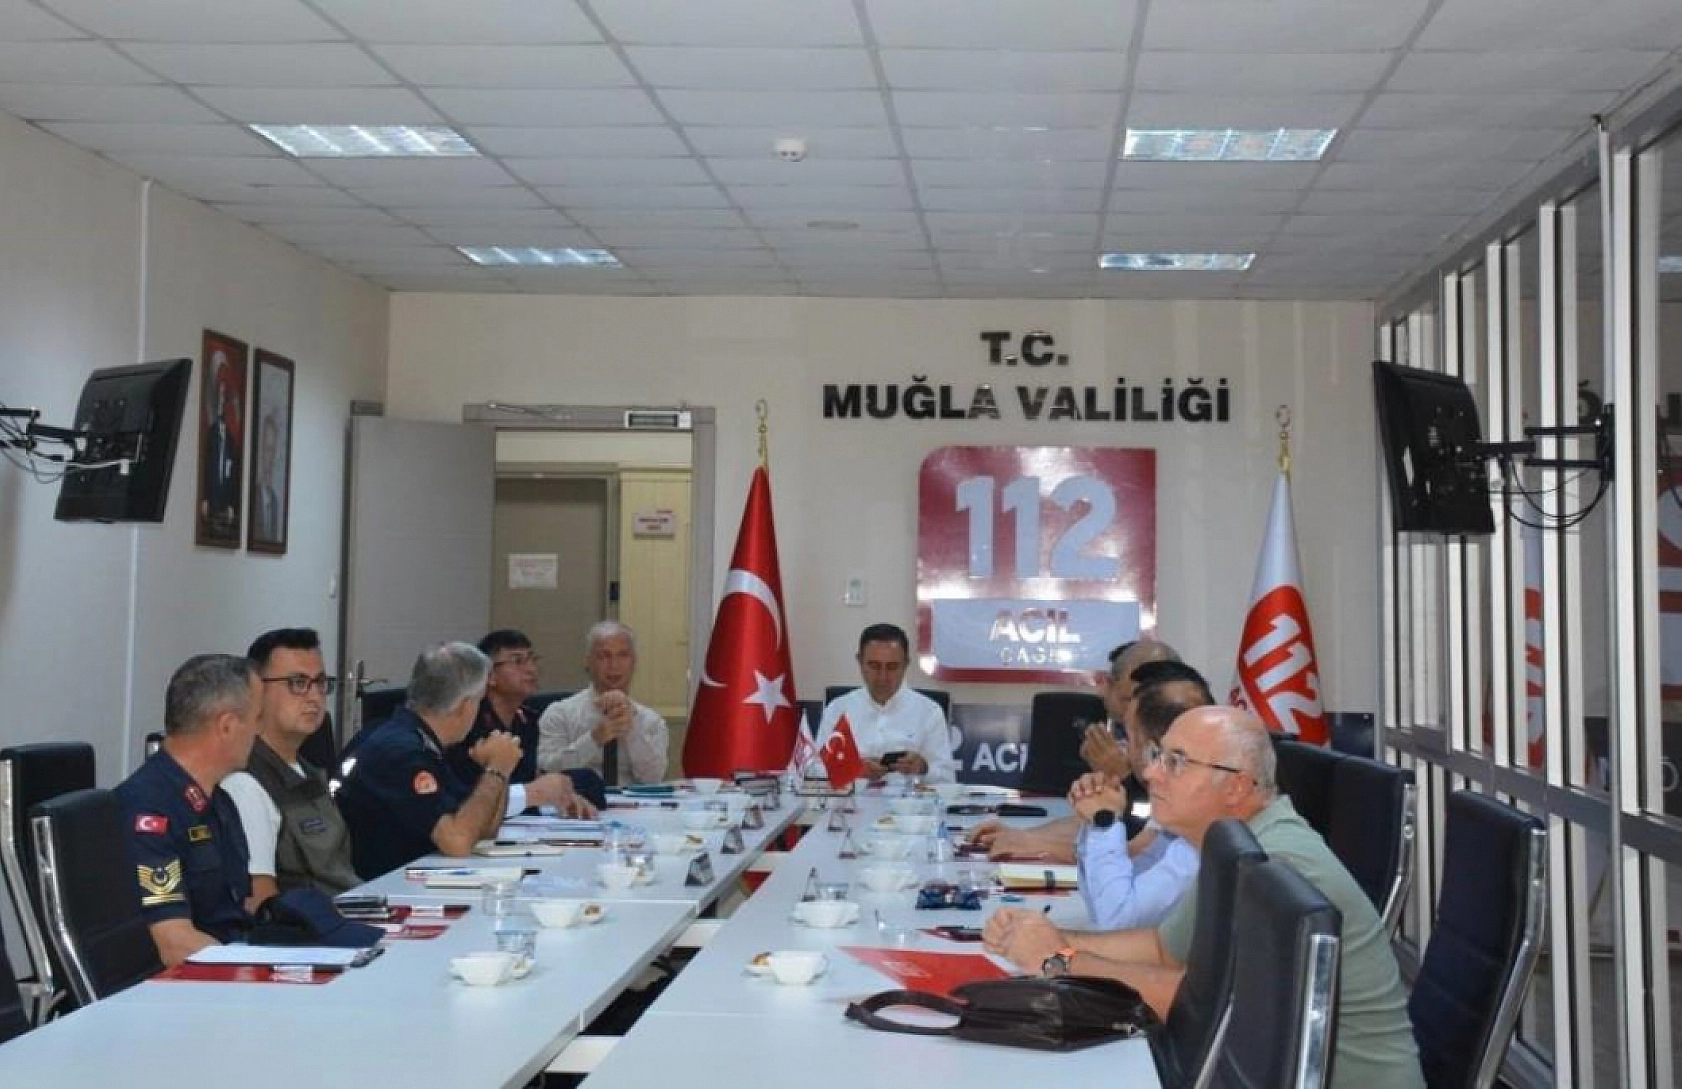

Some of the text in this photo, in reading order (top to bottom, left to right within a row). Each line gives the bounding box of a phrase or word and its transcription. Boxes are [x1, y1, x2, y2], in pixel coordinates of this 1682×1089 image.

[980, 331, 1069, 366] T.C.
[822, 374, 1231, 423] MUĞLA VALİLİĞİ
[956, 474, 1120, 580] 112
[1243, 613, 1324, 735] 112
